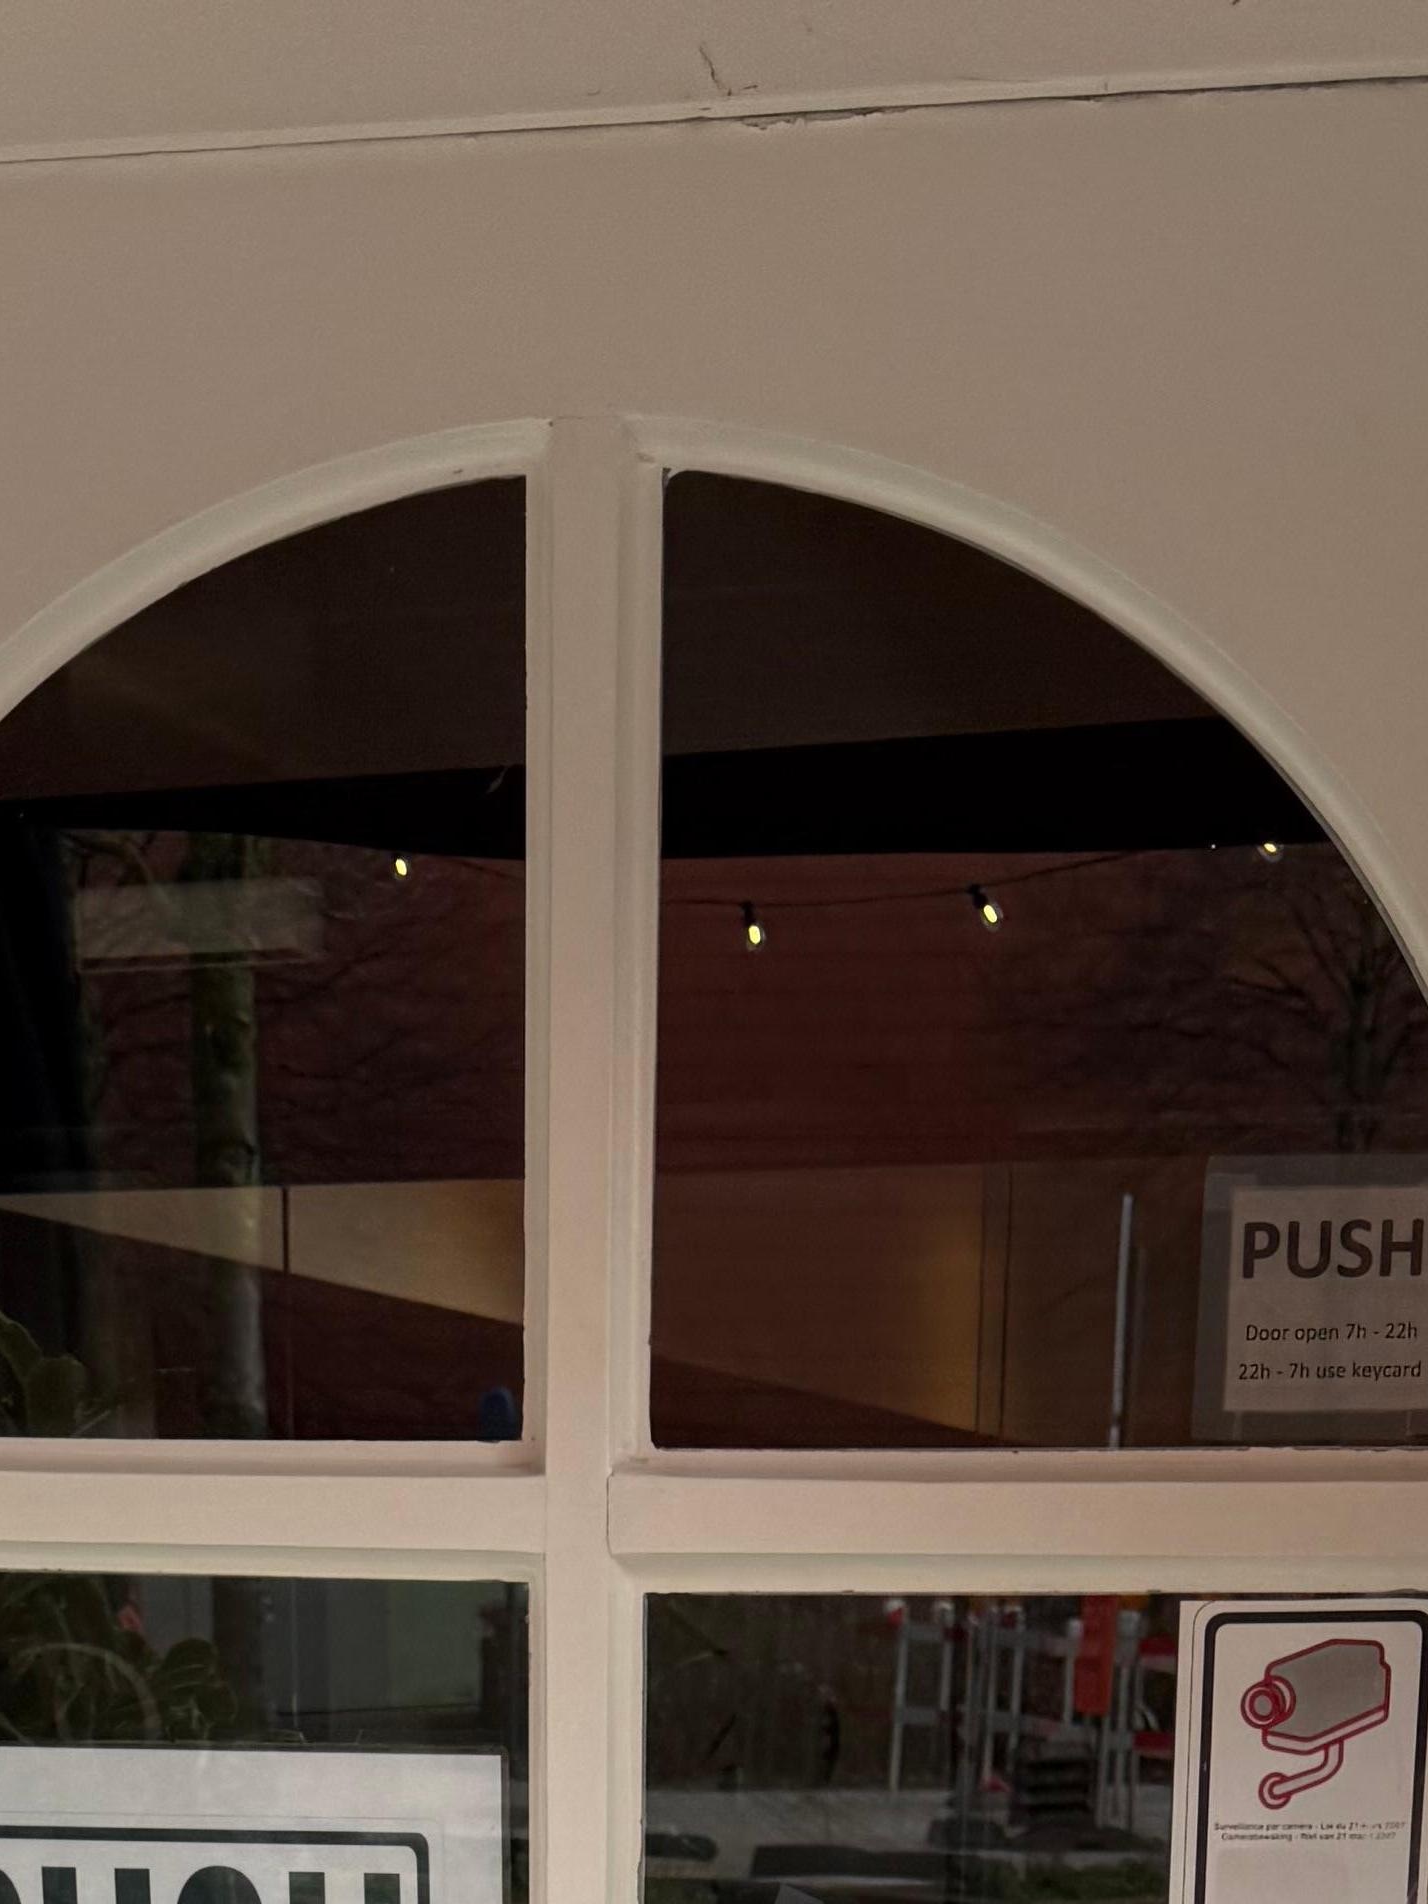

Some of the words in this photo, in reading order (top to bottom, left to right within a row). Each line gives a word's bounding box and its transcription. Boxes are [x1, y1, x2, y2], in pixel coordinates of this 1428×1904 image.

[1241, 1218, 1425, 1280] PUSH
[1245, 1323, 1290, 1342] Door
[1294, 1324, 1339, 1345] open
[1345, 1323, 1367, 1341] 7h
[1384, 1321, 1418, 1340] 22h
[1238, 1362, 1270, 1380] 22h
[1288, 1362, 1310, 1380] 7h
[1316, 1364, 1346, 1379] use
[1351, 1360, 1422, 1384] keycard
